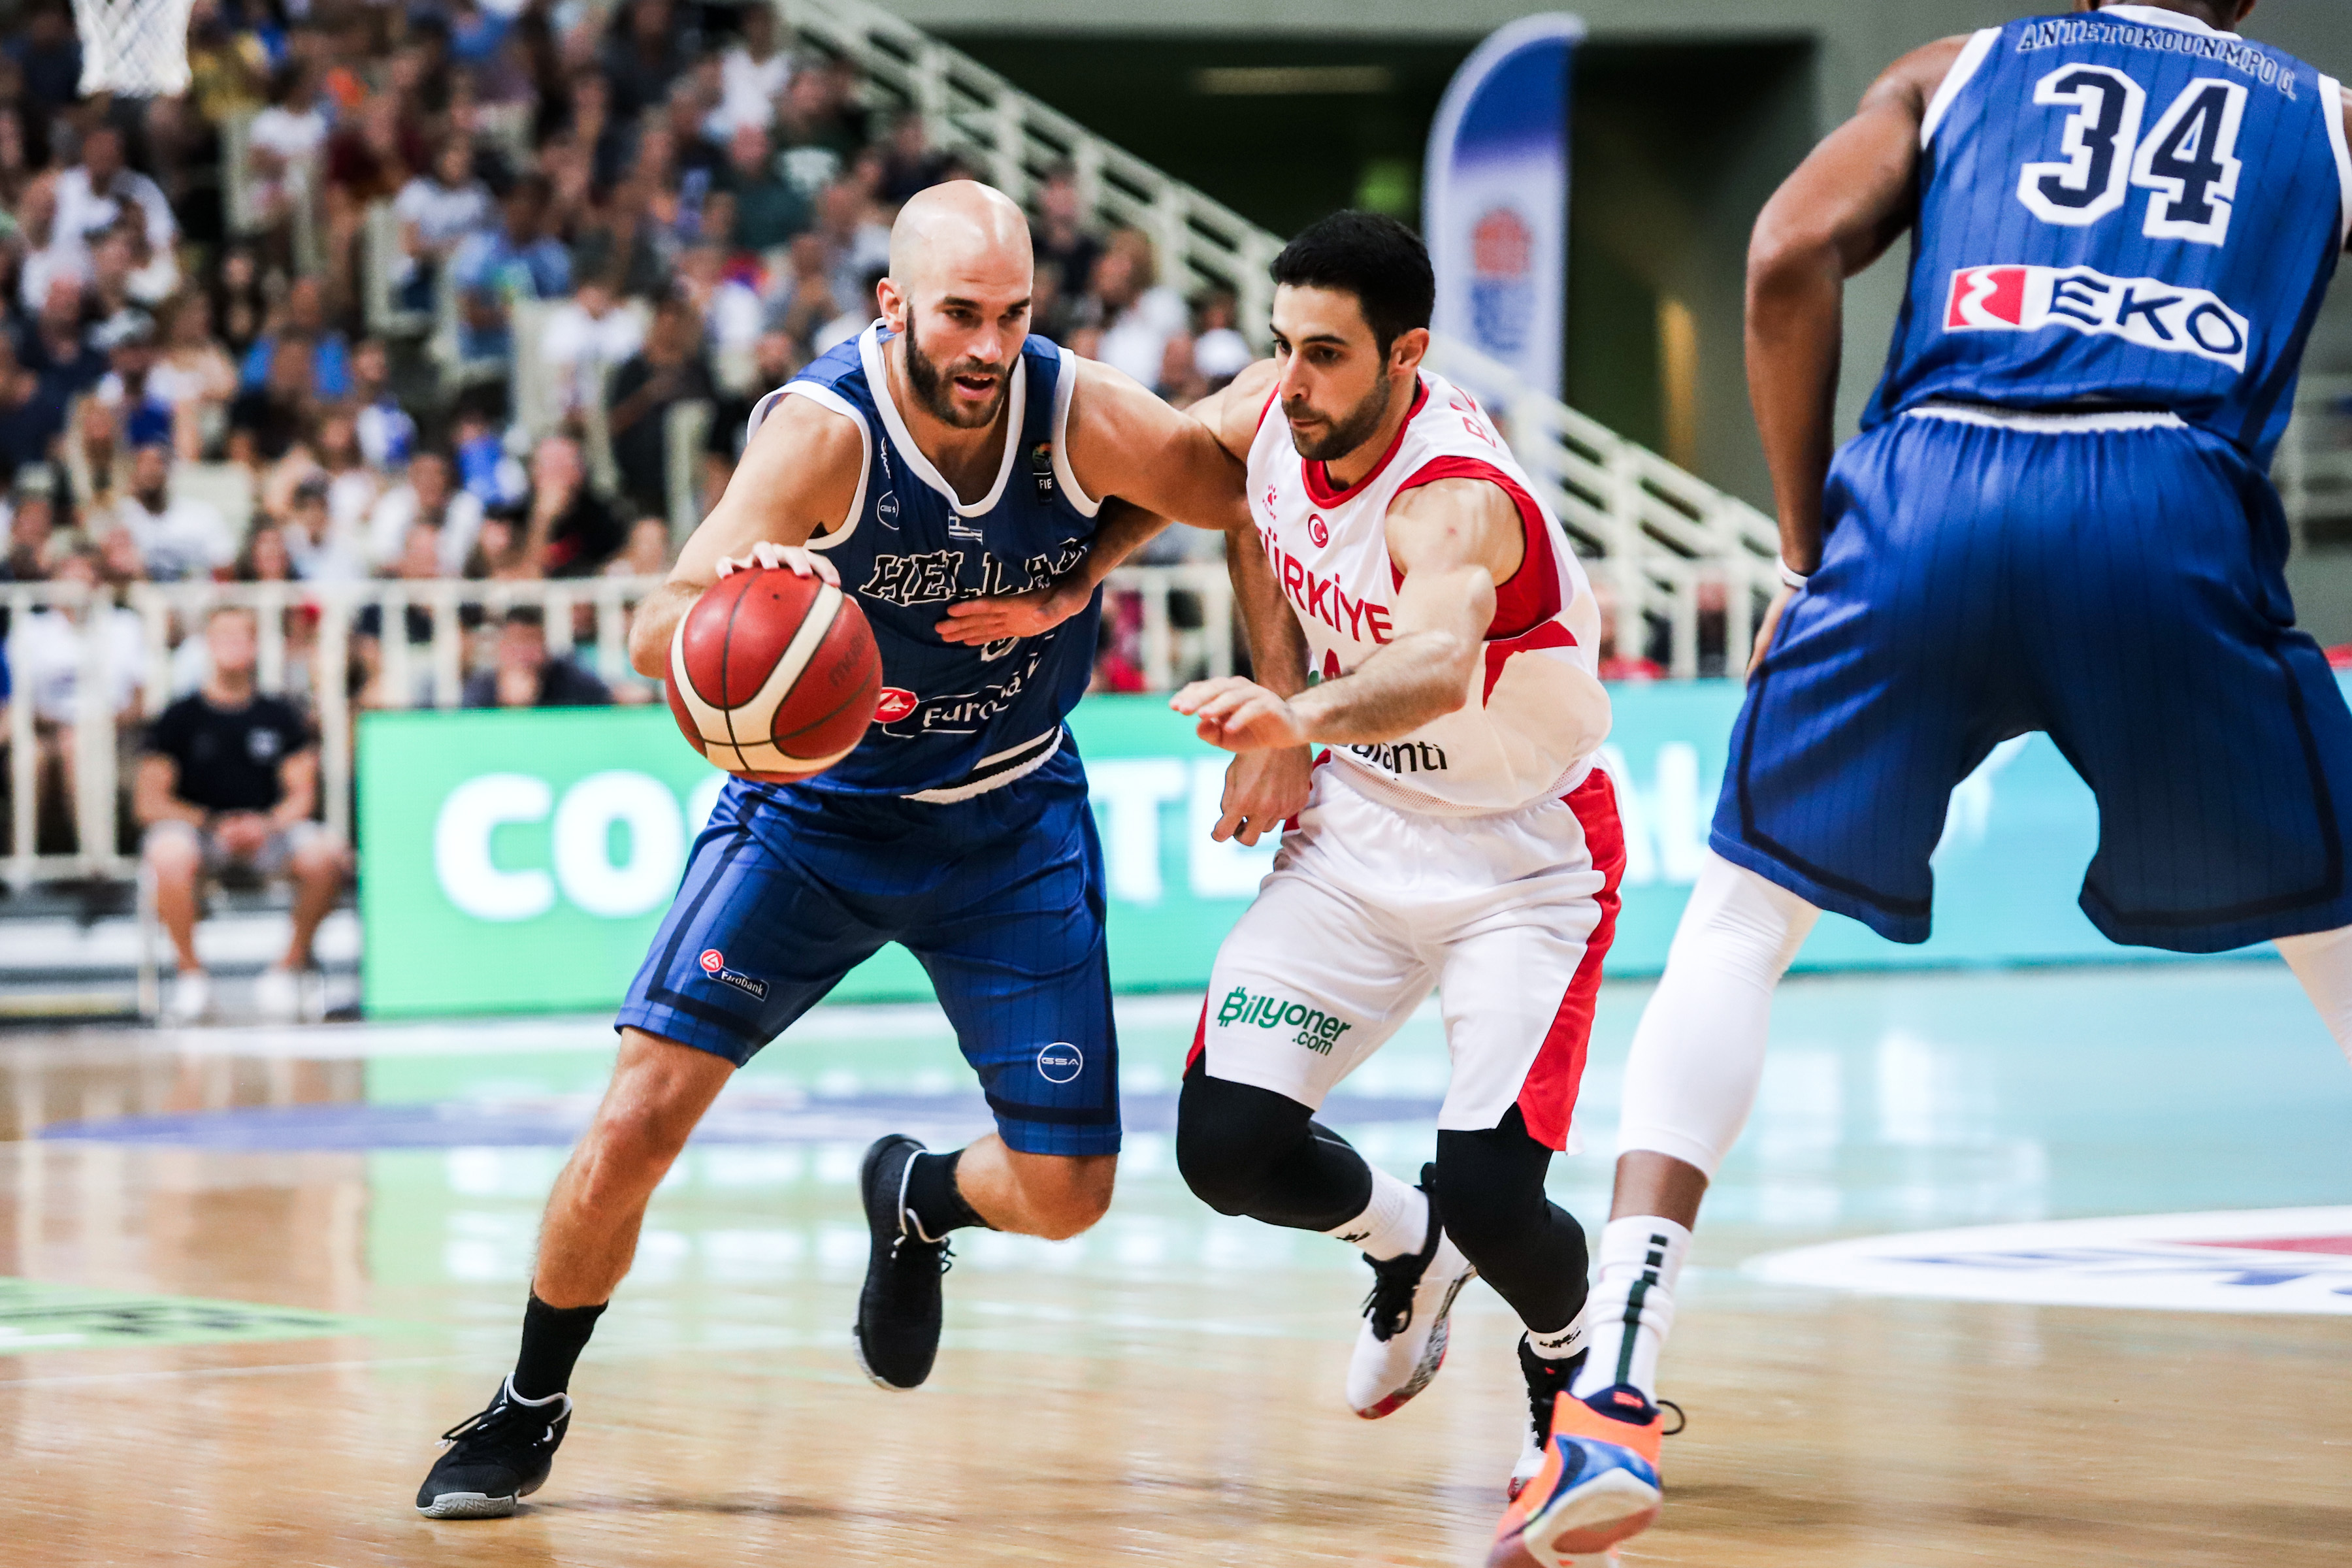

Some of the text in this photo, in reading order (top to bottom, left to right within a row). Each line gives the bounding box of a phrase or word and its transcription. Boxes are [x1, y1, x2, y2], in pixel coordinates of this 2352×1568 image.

[2017, 63, 2247, 247] 34
[2046, 274, 2243, 355] EKO
[1257, 527, 1393, 645] ÜRKİYE
[1217, 986, 1352, 1042] Bilyoner
[1292, 1031, 1333, 1056] .com
[1041, 1056, 1079, 1066] GSA
